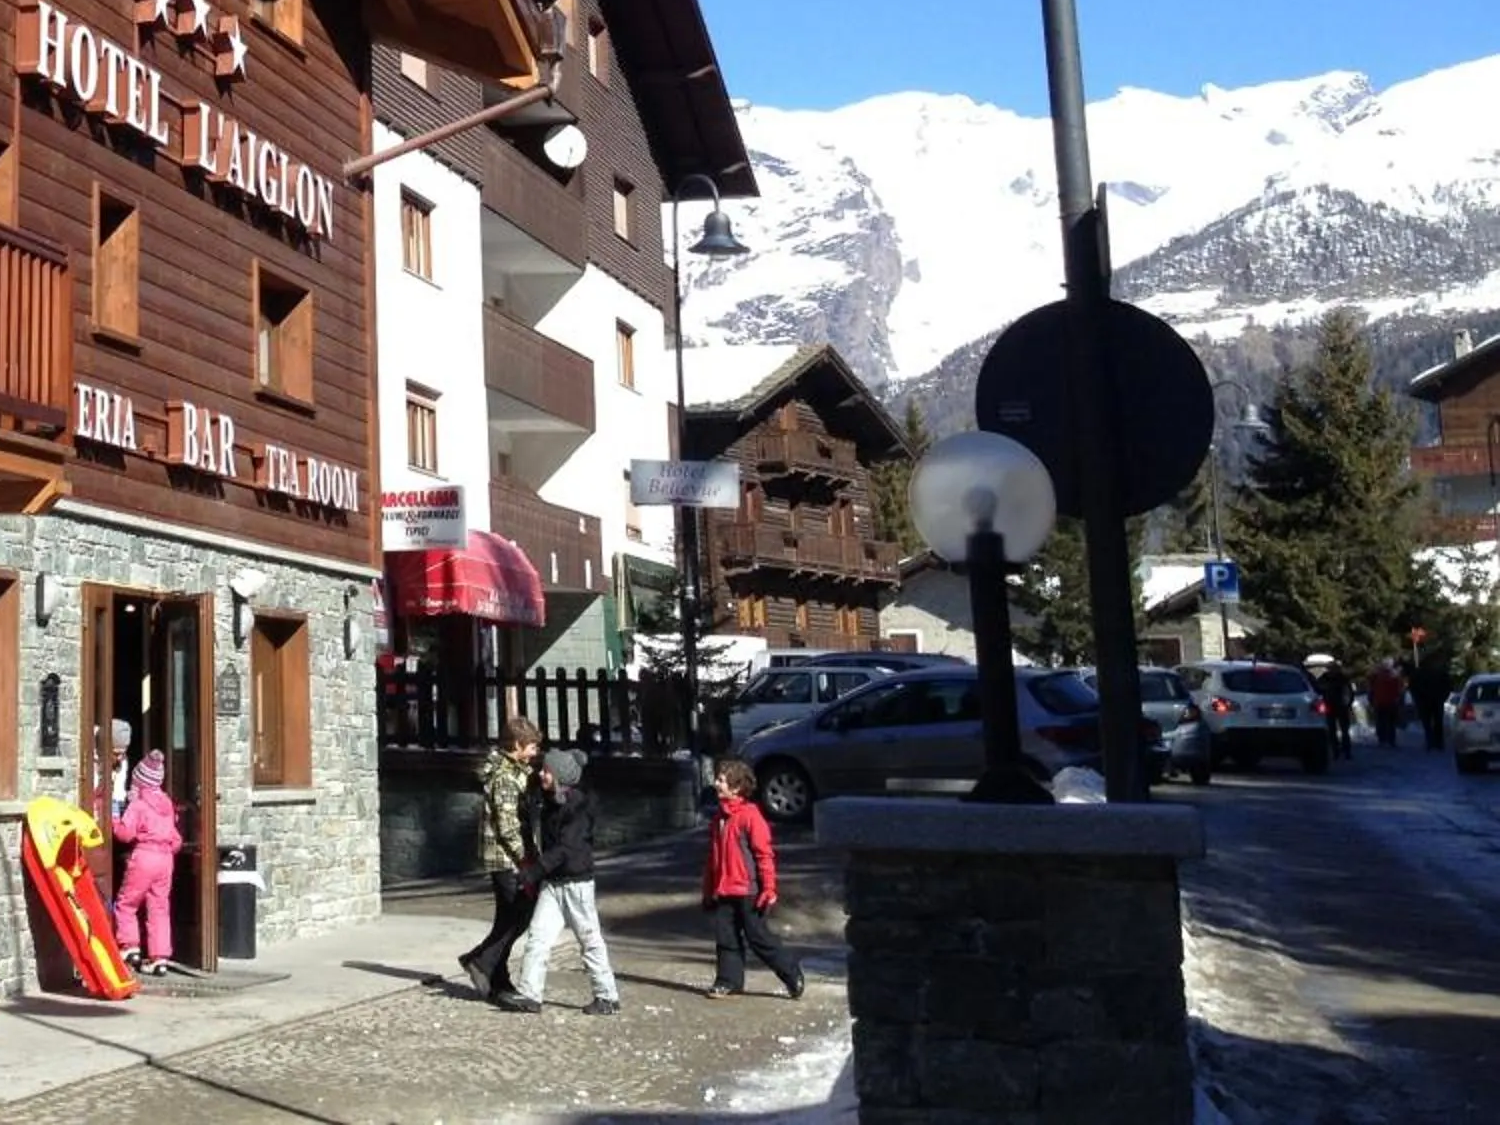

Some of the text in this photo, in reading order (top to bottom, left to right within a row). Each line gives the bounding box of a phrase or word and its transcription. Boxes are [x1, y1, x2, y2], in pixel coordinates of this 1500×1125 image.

[36, 0, 336, 241] HOTEL L'AIGLON
[74, 382, 359, 512] ERIA BAR TEA ROOM
[1211, 565, 1229, 588] P
